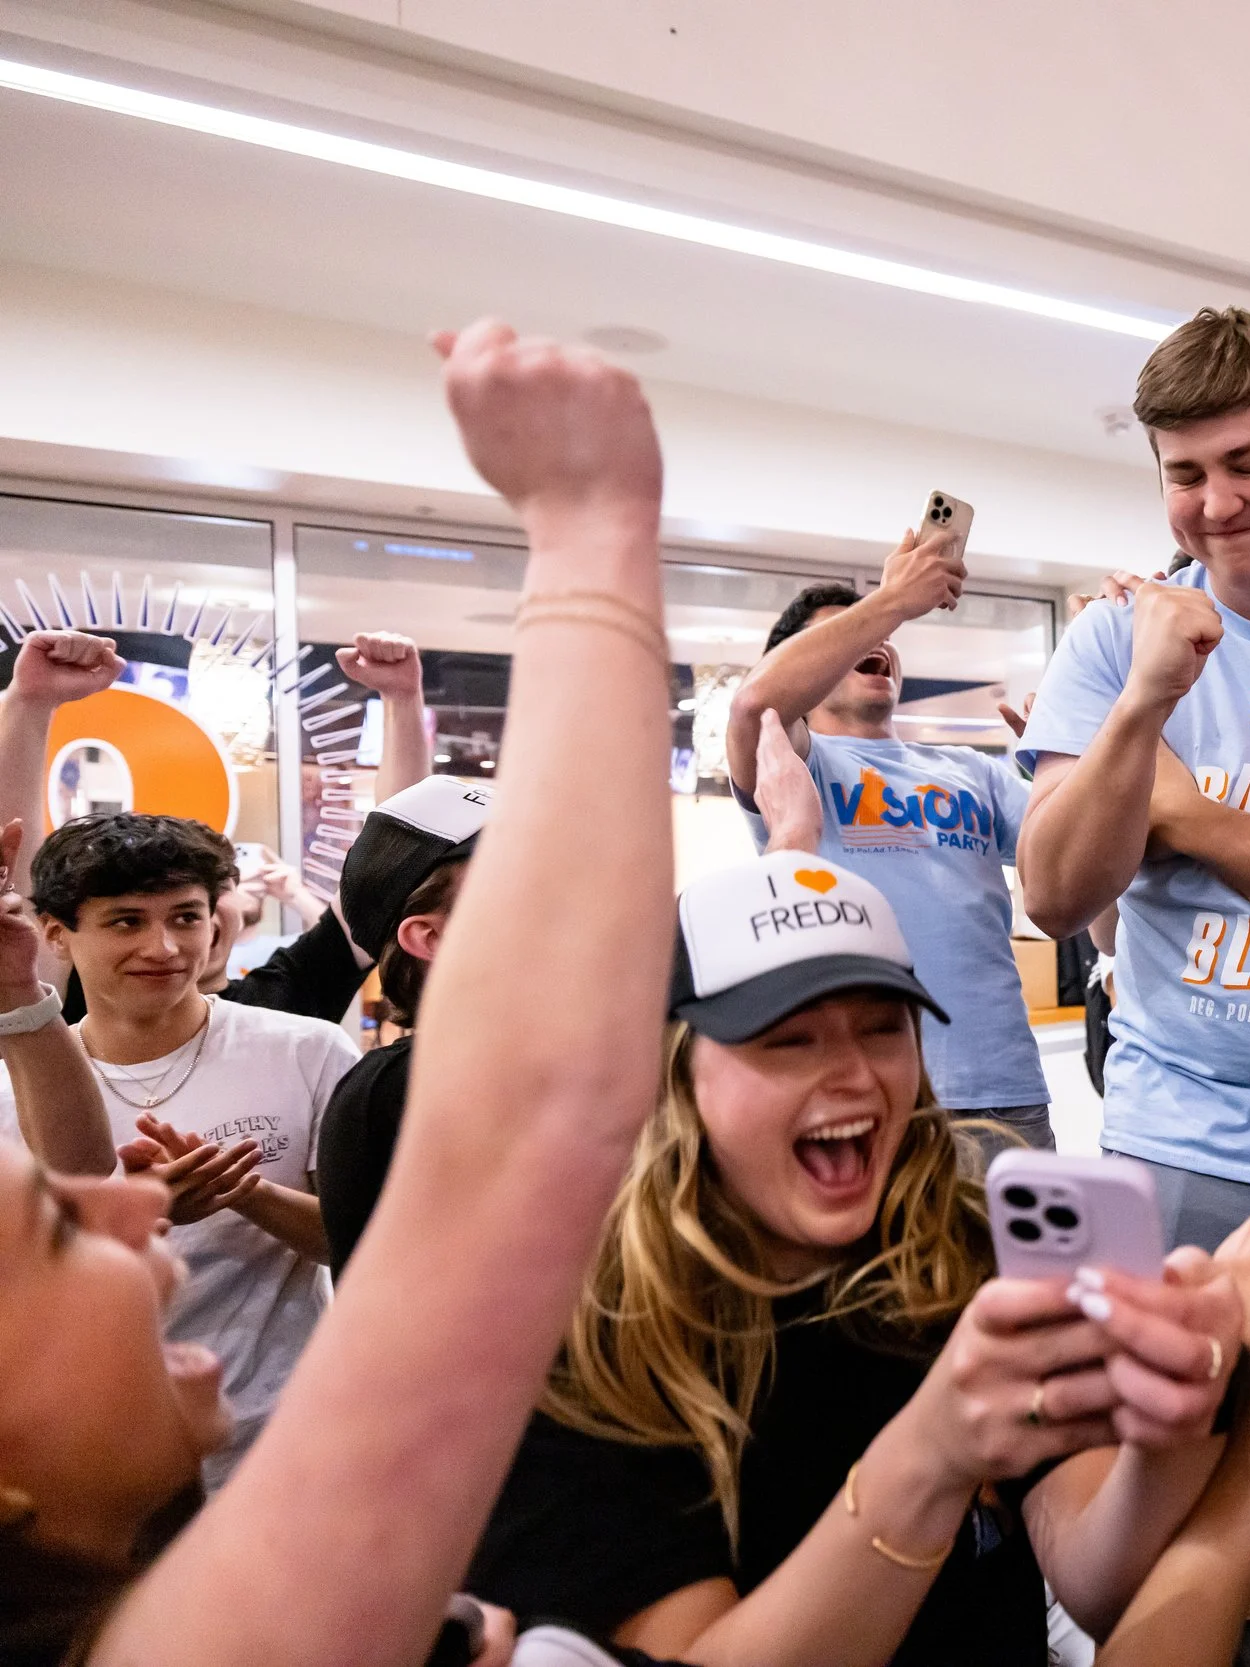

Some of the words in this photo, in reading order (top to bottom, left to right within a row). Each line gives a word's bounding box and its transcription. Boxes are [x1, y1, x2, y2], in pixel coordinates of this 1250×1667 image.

[937, 832, 991, 856] PARTY
[767, 875, 777, 899] I
[750, 900, 873, 942] FREDDI
[1189, 995, 1220, 1019] REG.
[204, 1115, 281, 1141] FILTHY
